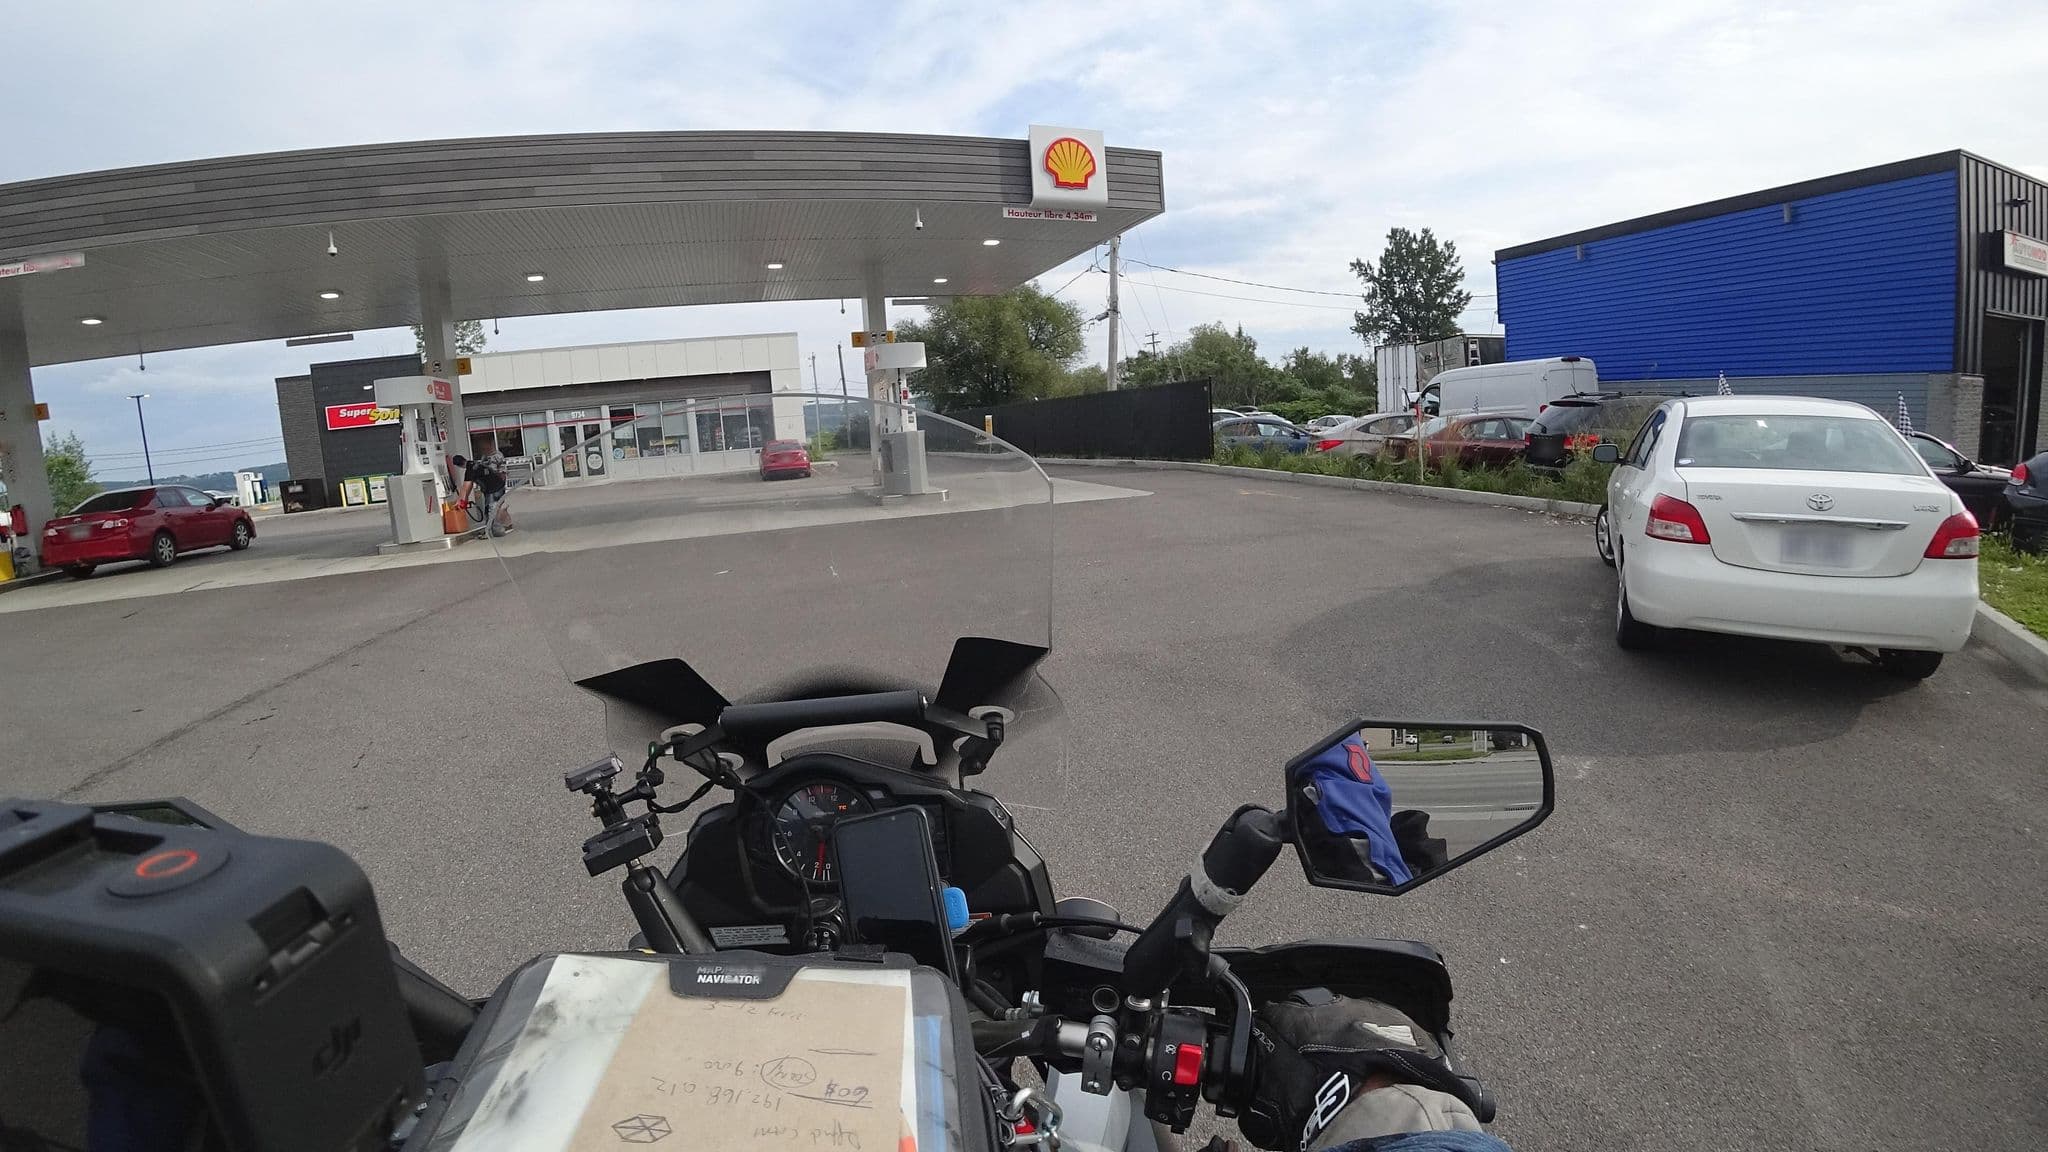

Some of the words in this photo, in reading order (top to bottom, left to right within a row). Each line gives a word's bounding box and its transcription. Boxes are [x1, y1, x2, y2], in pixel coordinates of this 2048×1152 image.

[1007, 208, 1042, 218] Hauteur
[1044, 209, 1064, 219] libre
[697, 974, 760, 985] NAVIGATOR
